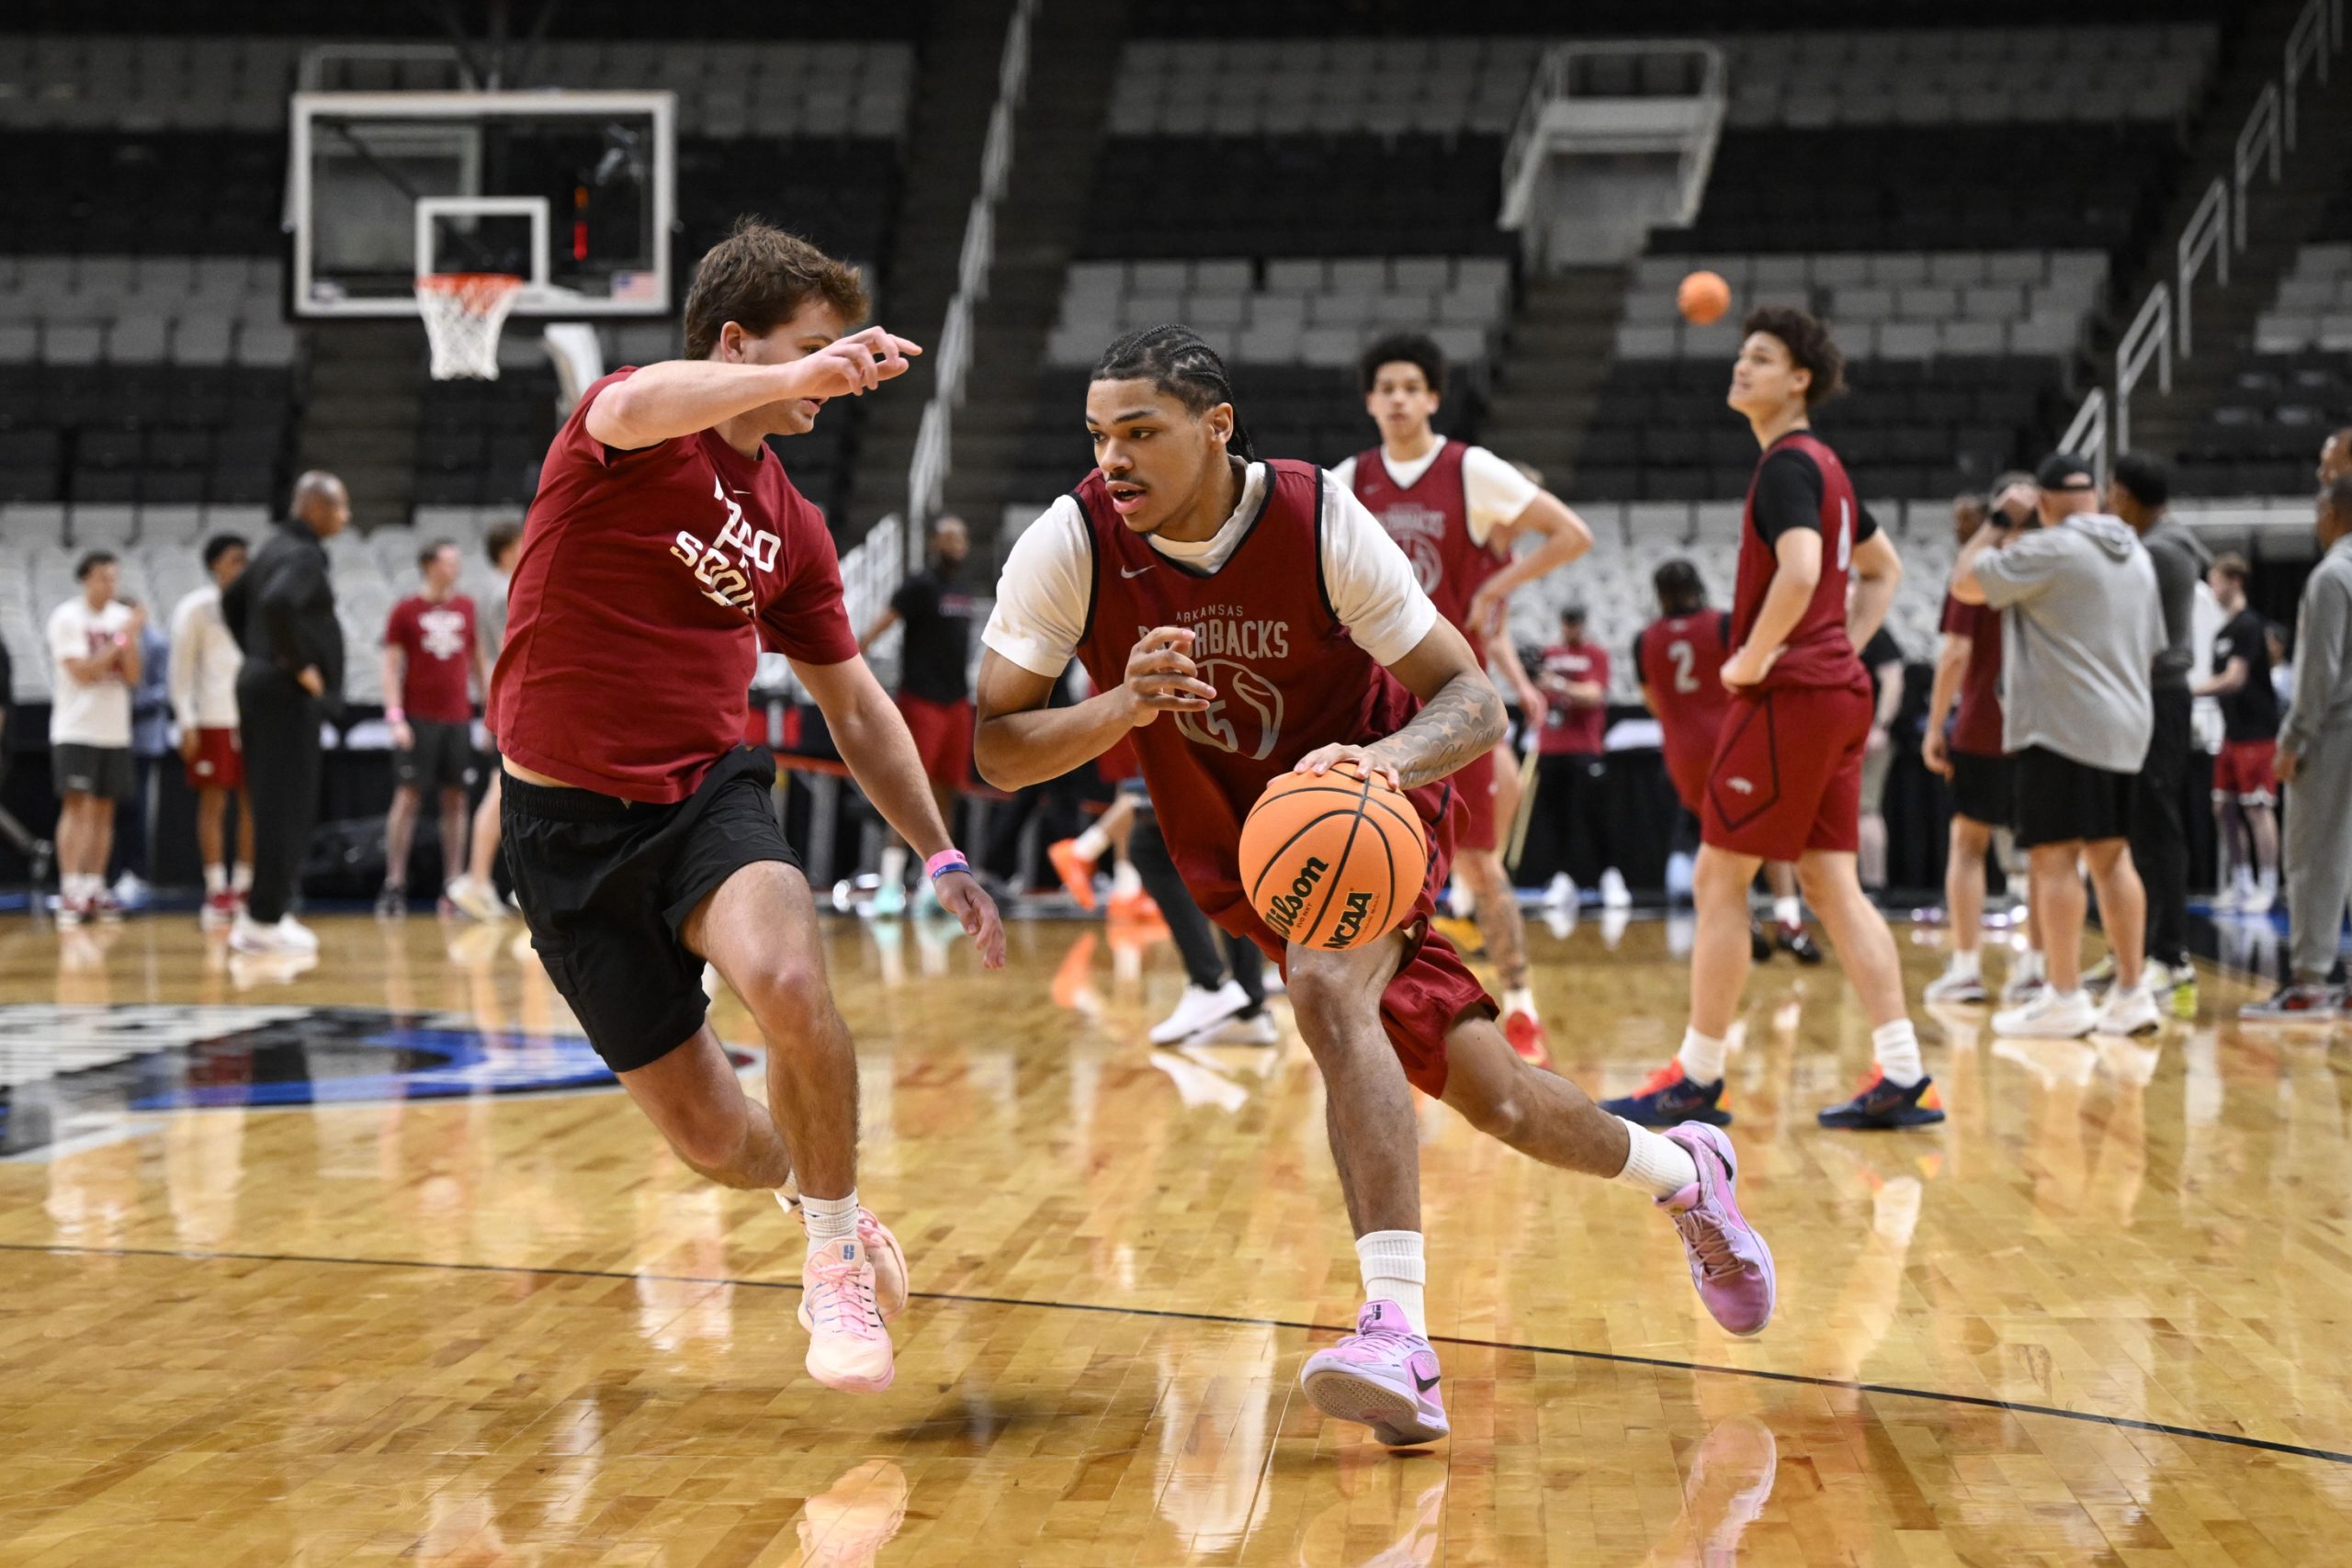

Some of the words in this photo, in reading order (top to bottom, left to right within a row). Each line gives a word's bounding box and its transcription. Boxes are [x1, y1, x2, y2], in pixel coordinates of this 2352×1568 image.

[1176, 604, 1244, 623] ARKANSAS
[1667, 639, 1700, 694] 2
[1264, 856, 1329, 939] Wilson
[1322, 891, 1374, 949] NCAA
